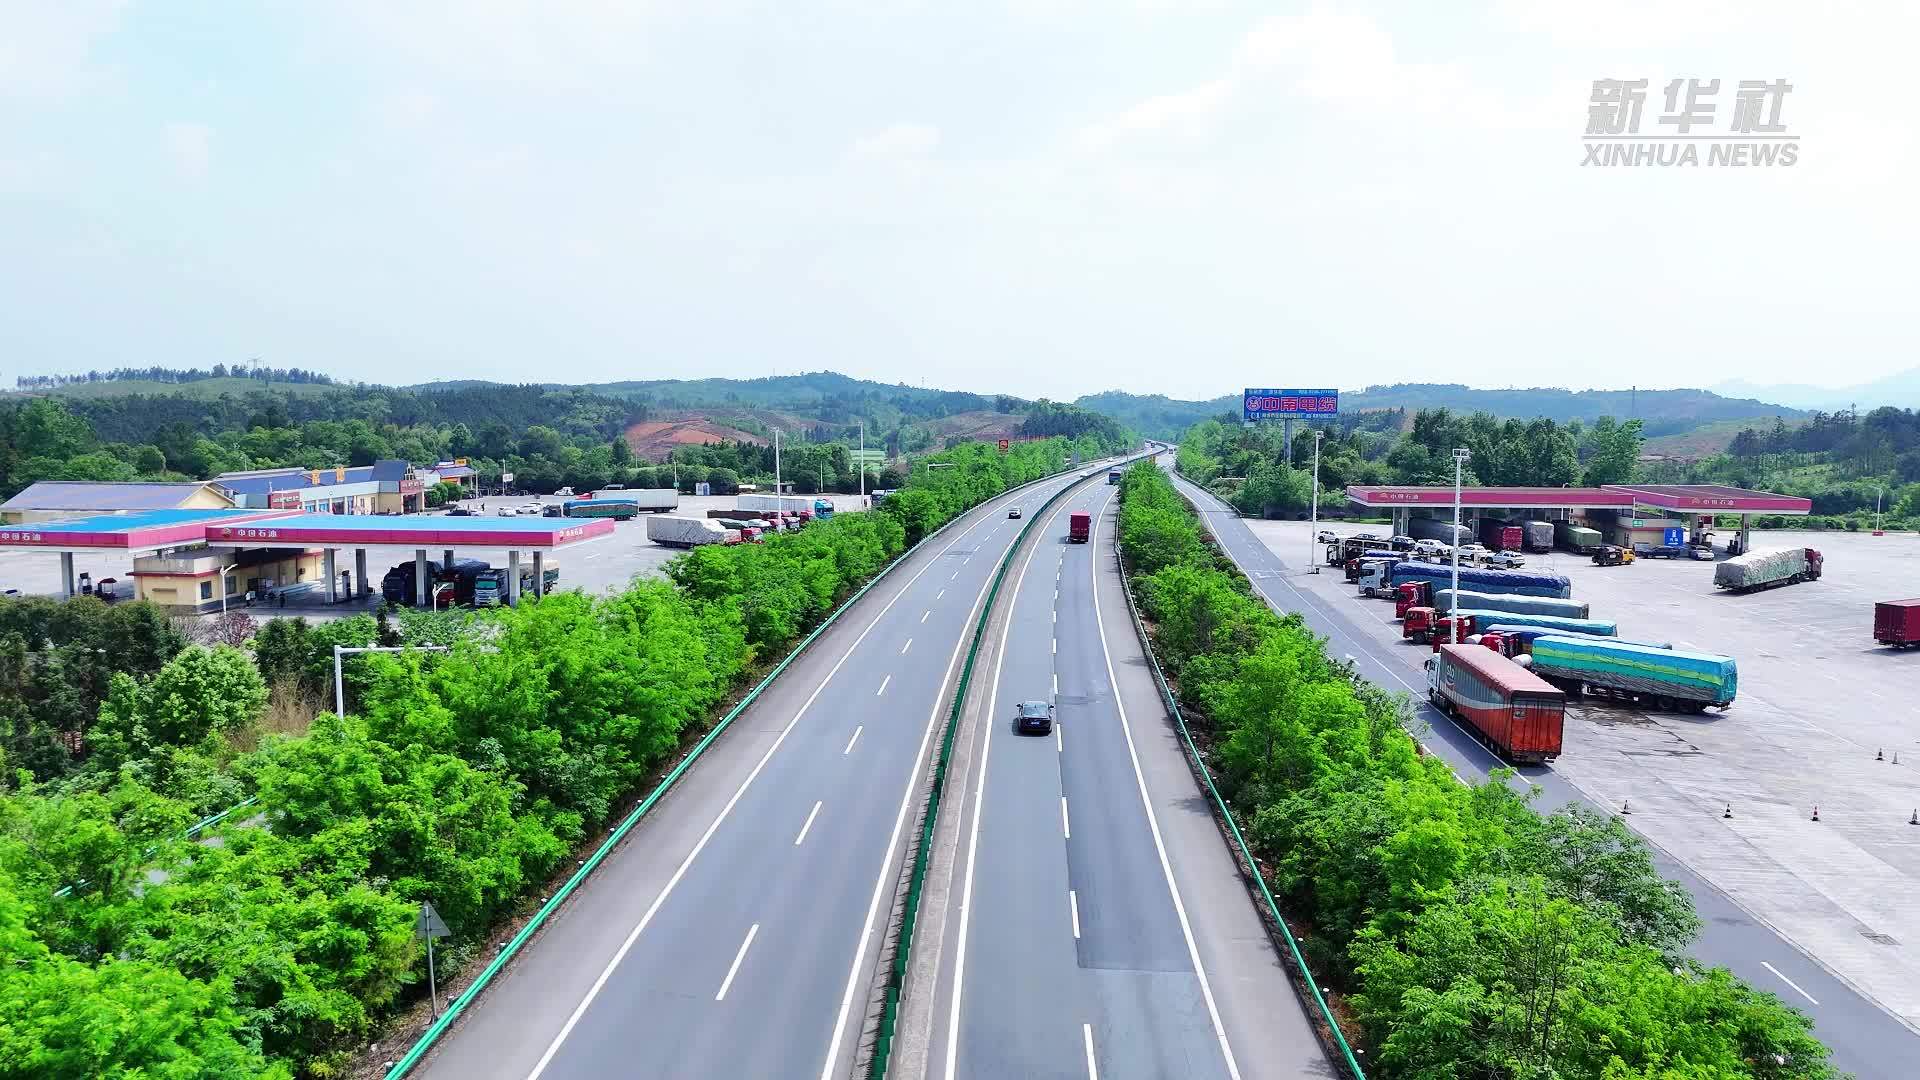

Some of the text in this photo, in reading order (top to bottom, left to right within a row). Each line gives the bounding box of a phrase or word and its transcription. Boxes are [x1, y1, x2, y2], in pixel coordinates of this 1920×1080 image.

[1261, 396, 1337, 412] 中南电缆
[1, 532, 41, 541] 中国石油
[237, 529, 277, 538] 中国石油
